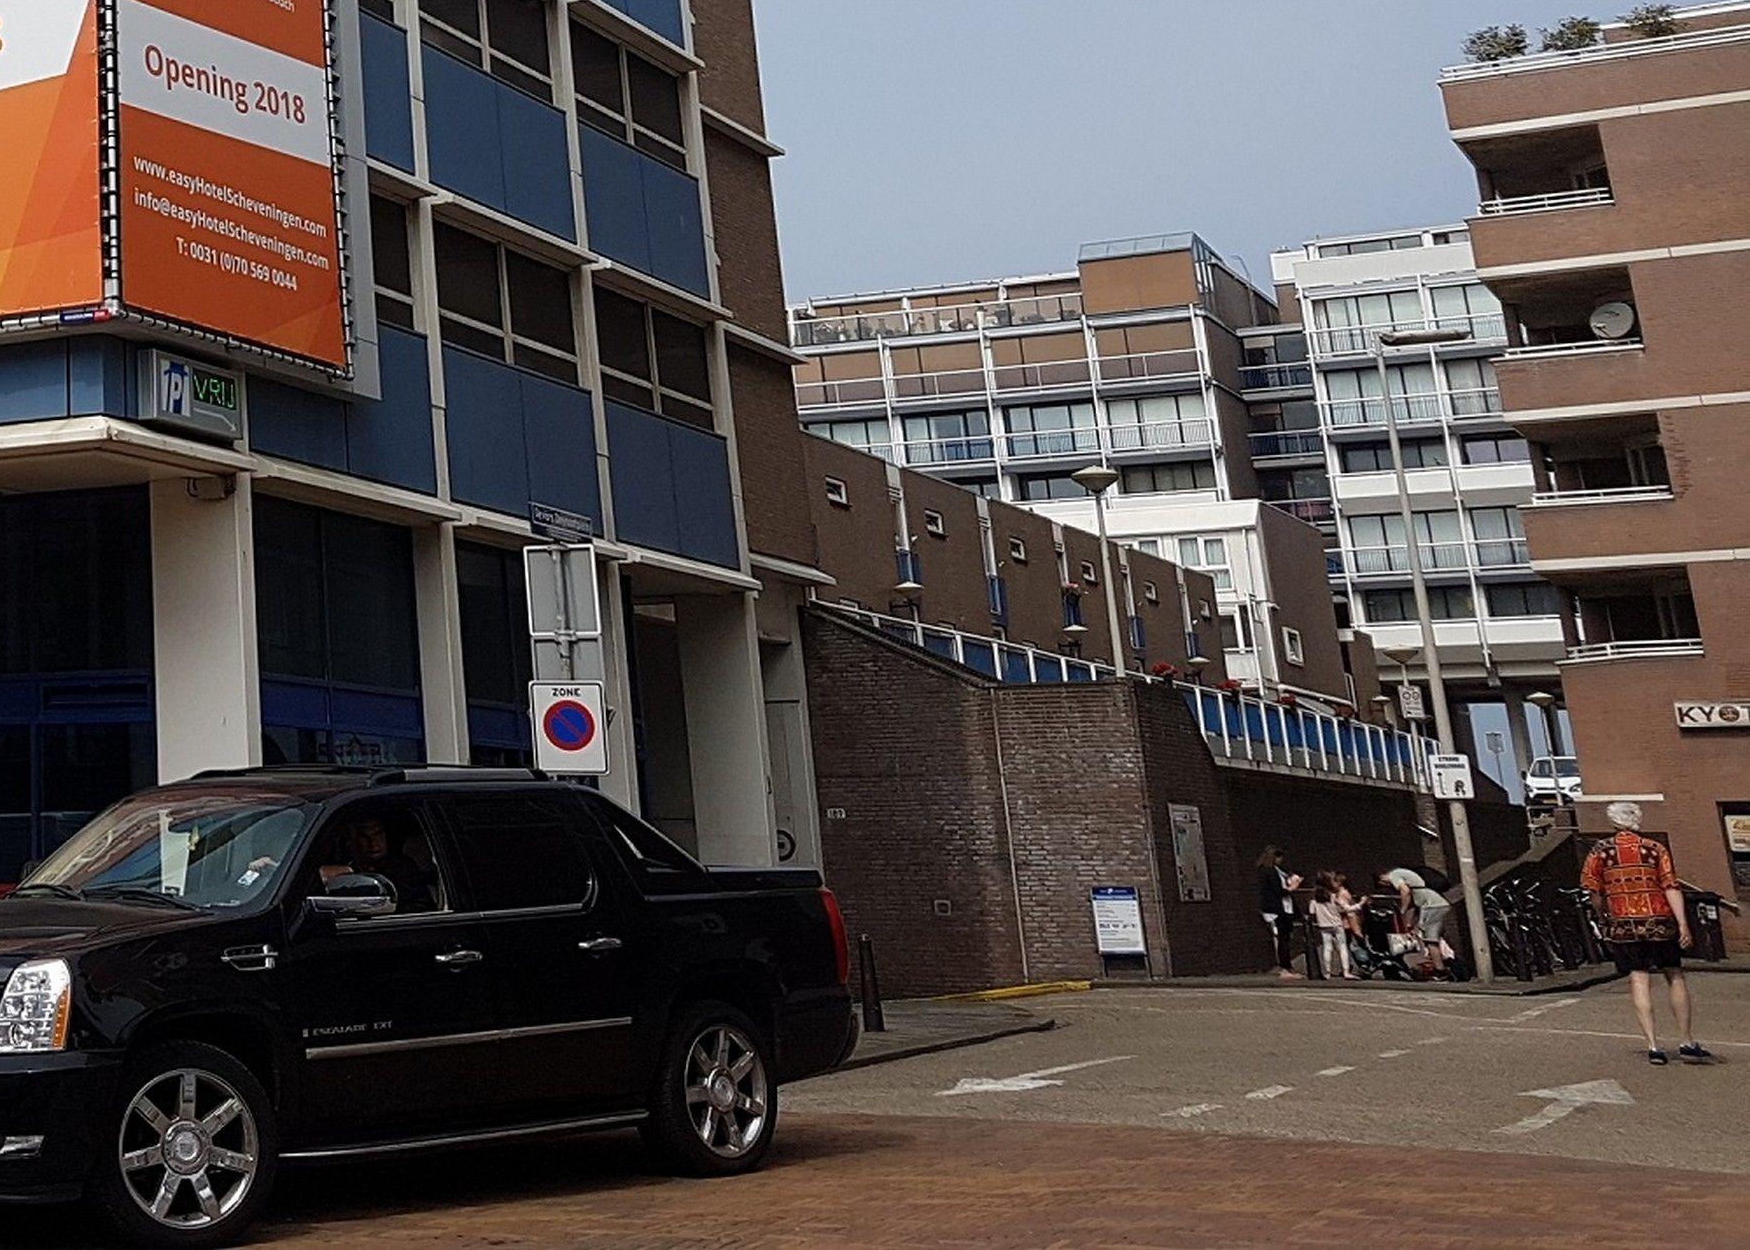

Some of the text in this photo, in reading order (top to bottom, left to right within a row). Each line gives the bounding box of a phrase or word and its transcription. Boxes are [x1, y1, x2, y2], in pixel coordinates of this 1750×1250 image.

[145, 44, 306, 124] Opening 2018
[133, 156, 327, 239] www.easyHotelScheveningen.com
[134, 187, 329, 270] info@easyHotelScheveningen.com
[176, 237, 297, 291] T: 0031 (0)70 569 0044
[193, 373, 235, 410] VRIJ
[552, 687, 581, 697] ZONE
